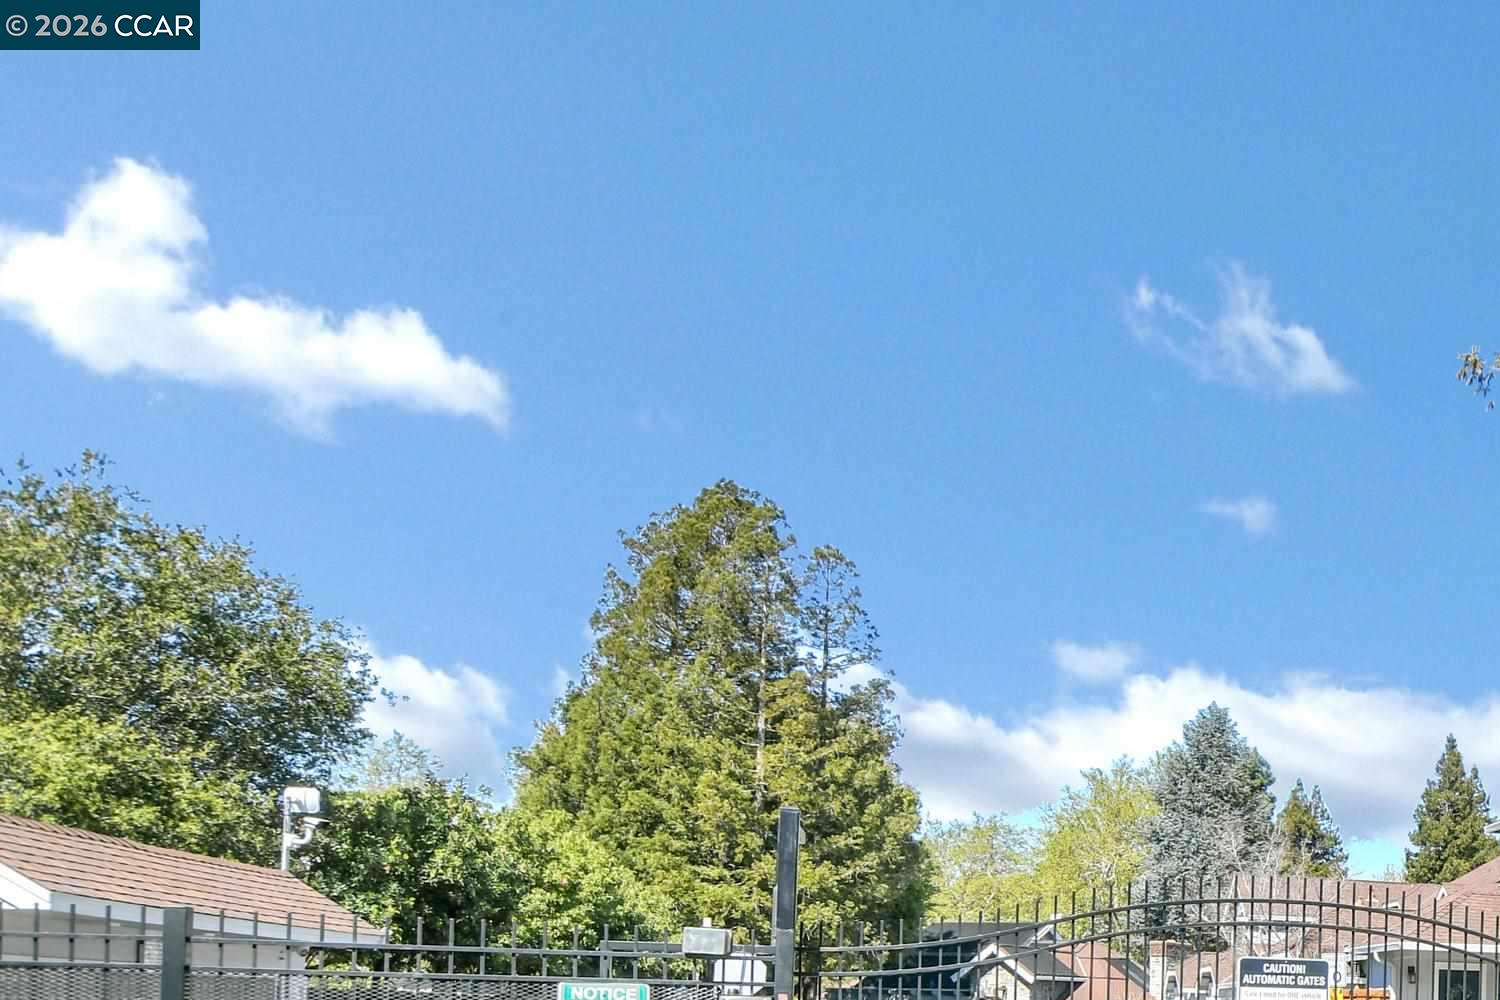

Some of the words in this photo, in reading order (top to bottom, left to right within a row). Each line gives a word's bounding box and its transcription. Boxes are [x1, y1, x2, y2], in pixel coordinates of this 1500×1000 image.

[1242, 974, 1295, 985] AUTOMATIC
[1297, 975, 1326, 986] GATES
[572, 986, 637, 1000] NOTICE
